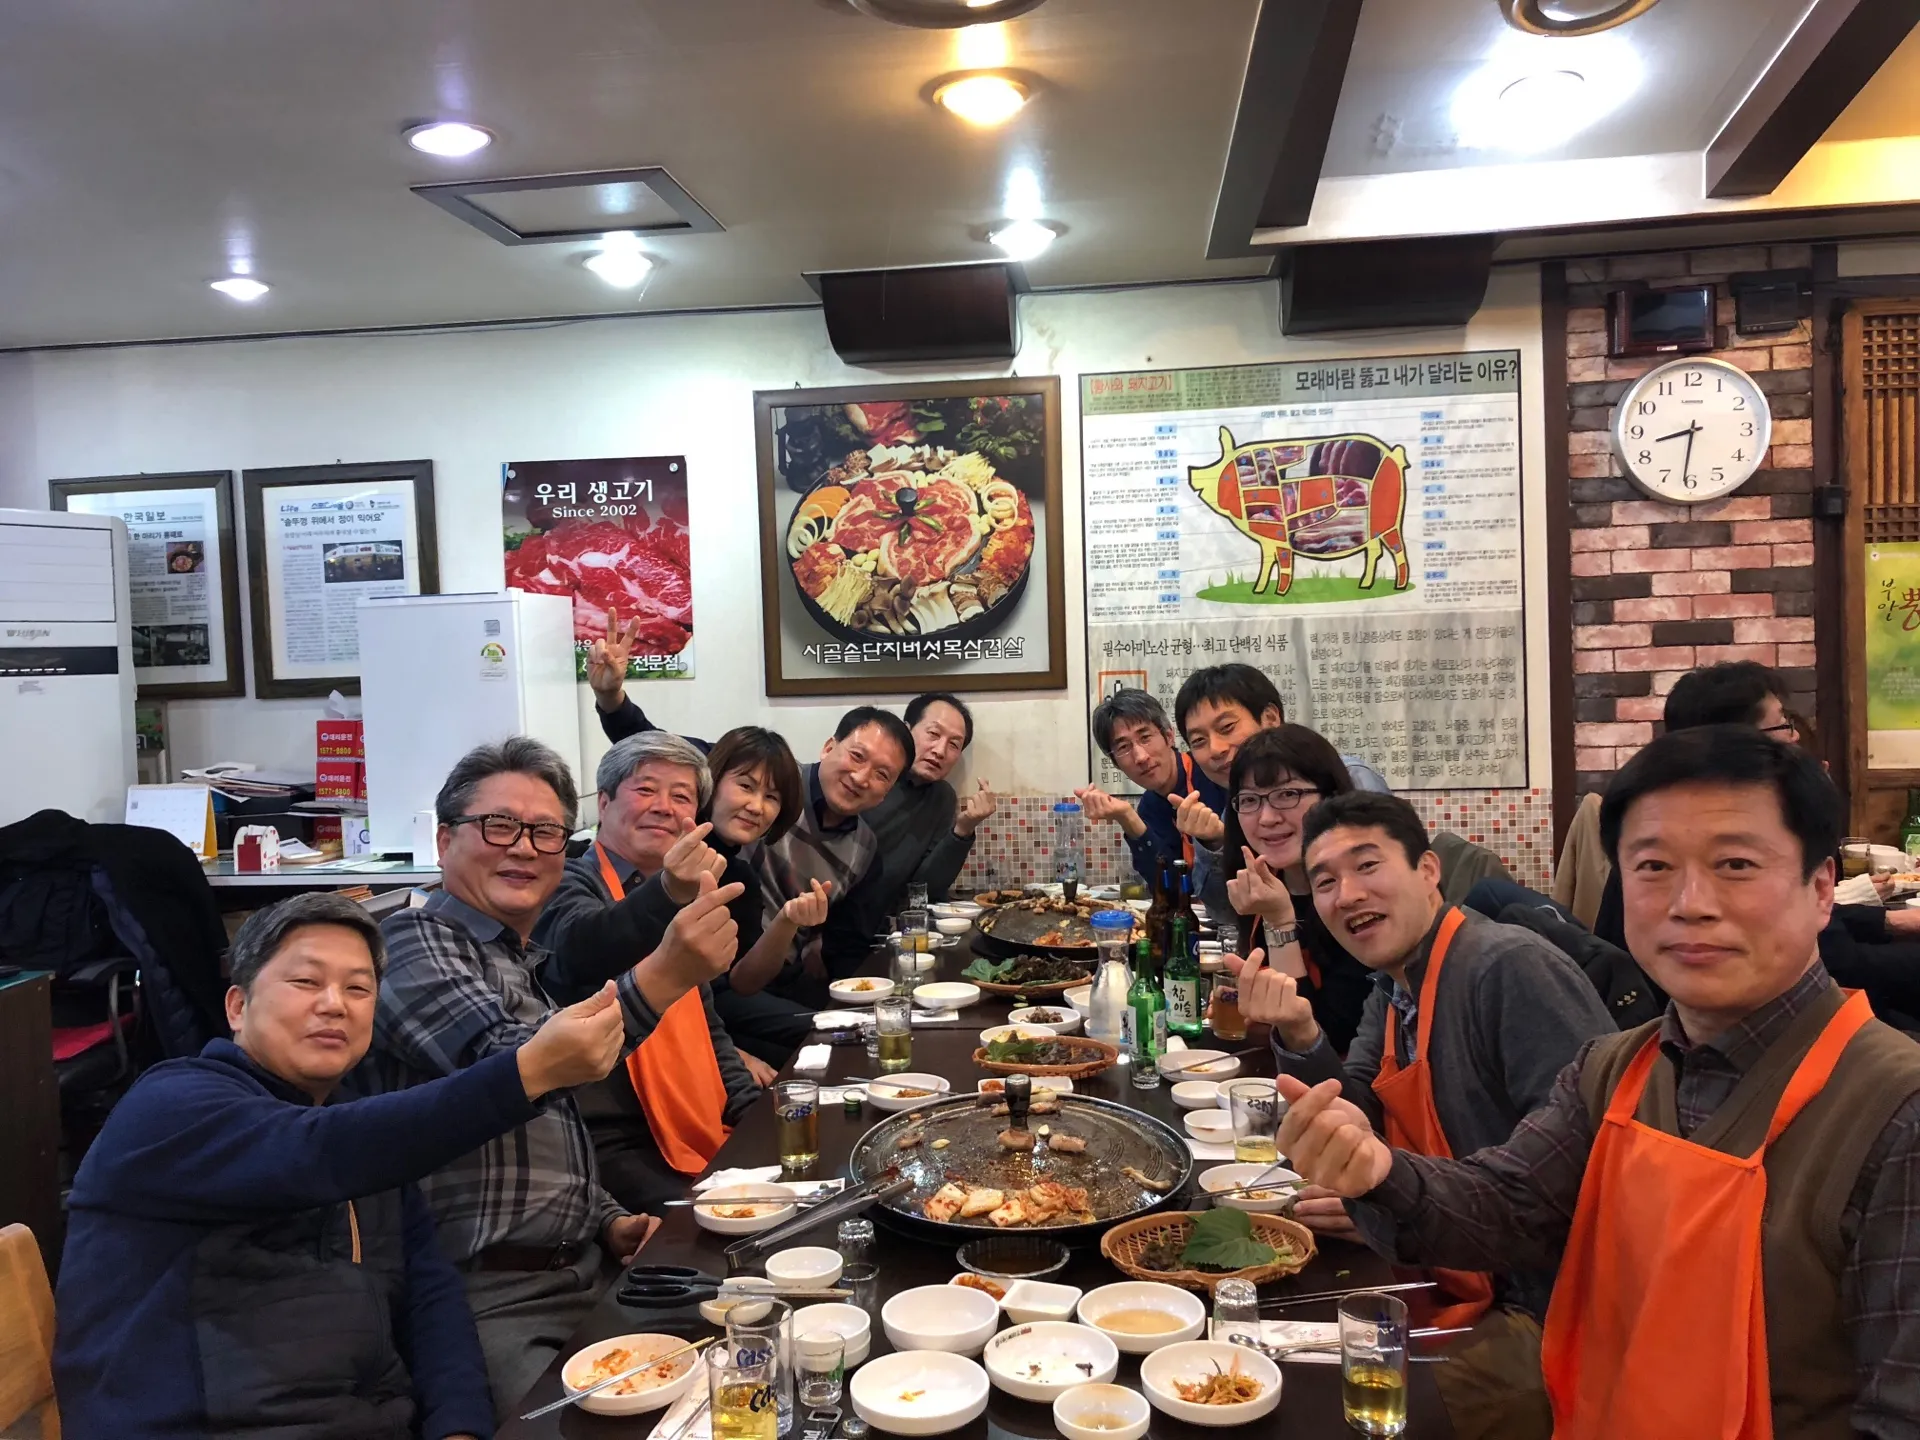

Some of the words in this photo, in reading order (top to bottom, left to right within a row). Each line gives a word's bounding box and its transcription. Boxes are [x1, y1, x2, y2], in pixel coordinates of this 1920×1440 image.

[1296, 368, 1356, 391] 모래바람
[1359, 366, 1390, 388] 뚫고
[1394, 363, 1424, 386] 내가
[1428, 361, 1473, 384] 달리는
[1477, 359, 1517, 382] 이유?
[1684, 372, 1703, 387] 12
[1658, 381, 1674, 396] 11
[1716, 378, 1723, 393] 1
[1638, 401, 1656, 415] 10
[1732, 396, 1745, 411] 2
[1630, 425, 1644, 440] 9
[1740, 422, 1753, 437] 3
[1638, 449, 1652, 465] 8
[1731, 448, 1745, 462] 4
[1658, 469, 1672, 483] 7
[1684, 474, 1698, 489] 6
[1710, 467, 1724, 481] 5
[534, 483, 577, 506] 우리
[587, 479, 653, 503] 생고기
[552, 505, 595, 518] Since
[600, 504, 637, 517] 2002
[311, 515, 335, 525] 위에서
[339, 515, 354, 524] 정이
[803, 637, 1025, 664] 시골솥단지버섯목삼겹살
[1103, 638, 1170, 657] 필수아미노산
[1230, 635, 1263, 653] 단백질
[1265, 634, 1289, 651] 식품
[633, 655, 679, 671] 전문점
[1158, 683, 1174, 694] 20%
[1172, 984, 1186, 1002] 참
[1174, 1001, 1192, 1018] 이슬
